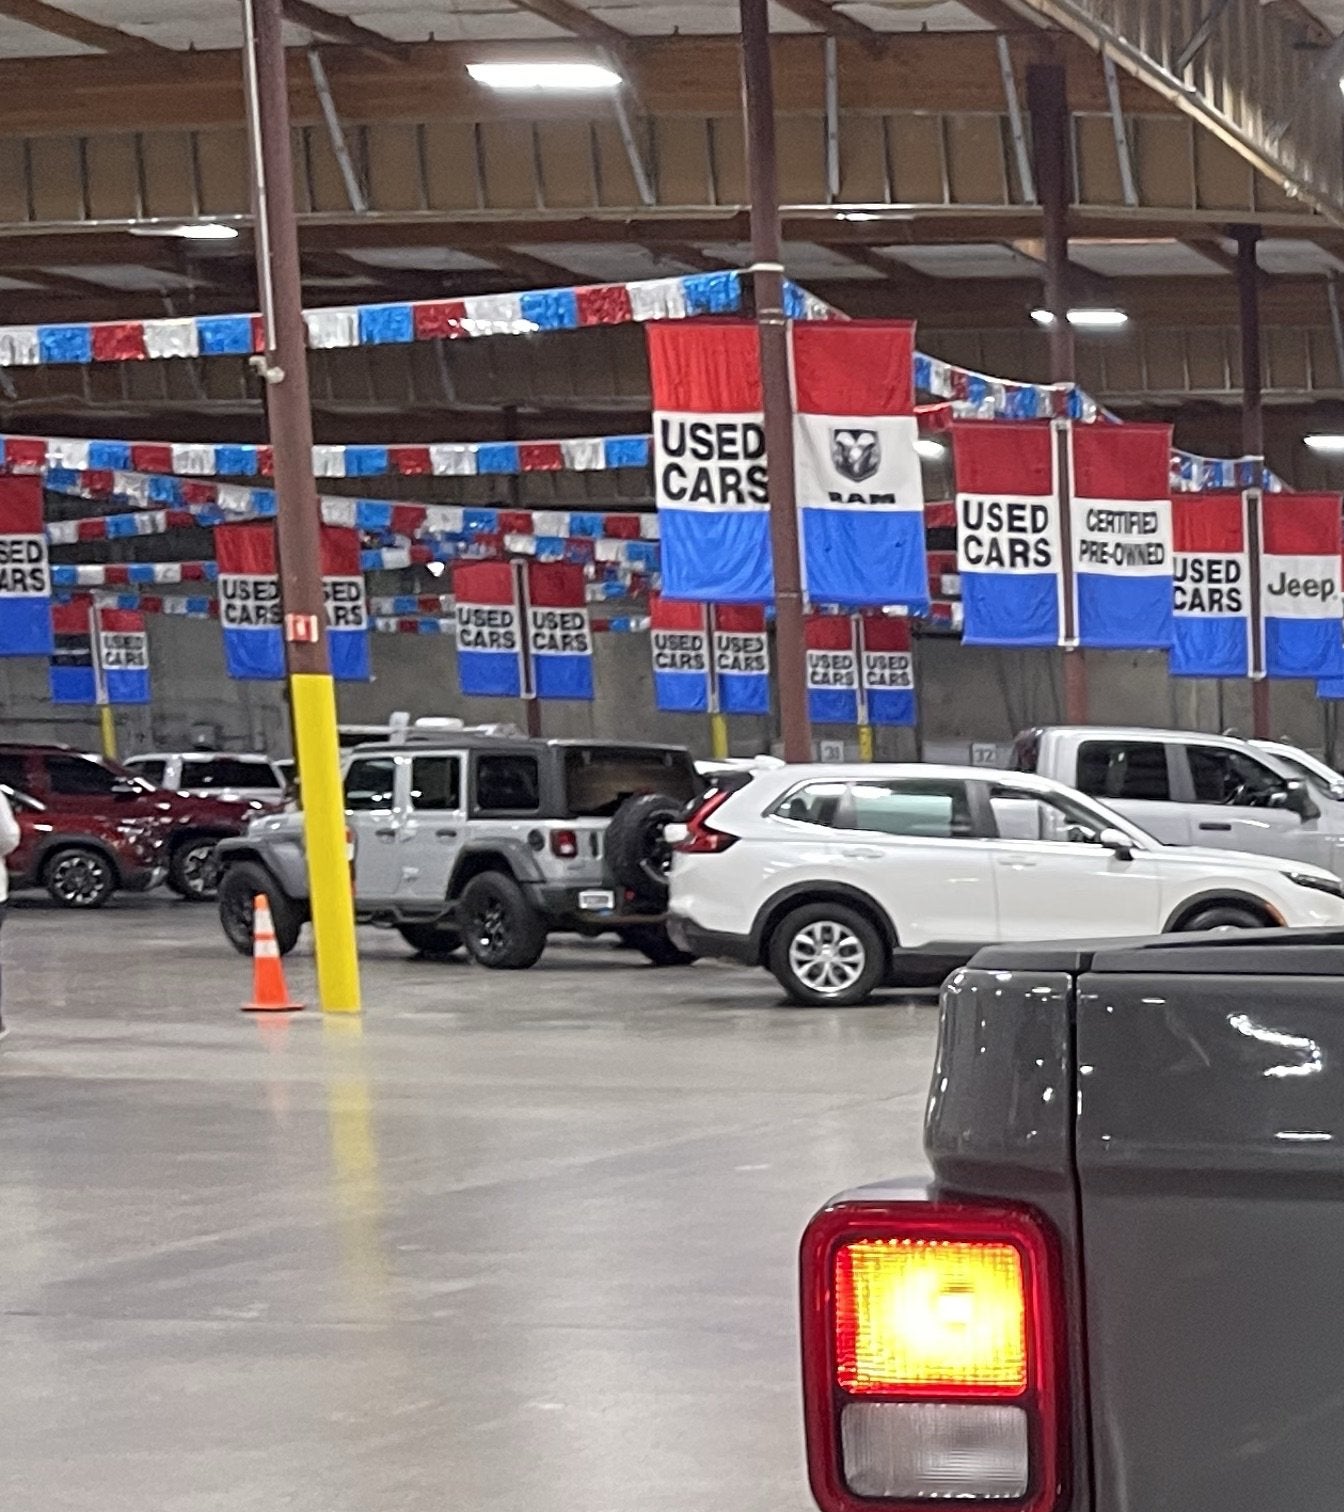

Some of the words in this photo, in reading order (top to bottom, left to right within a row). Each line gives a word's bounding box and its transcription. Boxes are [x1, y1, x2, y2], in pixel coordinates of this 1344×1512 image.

[661, 419, 765, 461] USED
[662, 462, 769, 504] CARS
[963, 500, 1048, 534] USED
[1086, 508, 1158, 534] CERTIFIED
[0, 540, 43, 564] SED
[963, 534, 1052, 568] CARS
[1079, 539, 1165, 566] PRE-OWNED
[0, 568, 46, 592] ARS
[1173, 556, 1241, 584] USED
[222, 579, 281, 601] USED
[1267, 572, 1336, 602] Jeep
[1173, 586, 1243, 613] CARS
[457, 607, 514, 628] USED
[532, 611, 585, 631] USED
[459, 629, 516, 649] CARS
[532, 632, 589, 652] CARS
[654, 633, 702, 650] USED
[717, 635, 764, 652] USED
[655, 652, 705, 670] CARS
[717, 653, 767, 671] CARS
[809, 653, 853, 669] USED
[866, 655, 908, 670] USED
[810, 671, 855, 687] CARS
[866, 671, 910, 687] CARS
